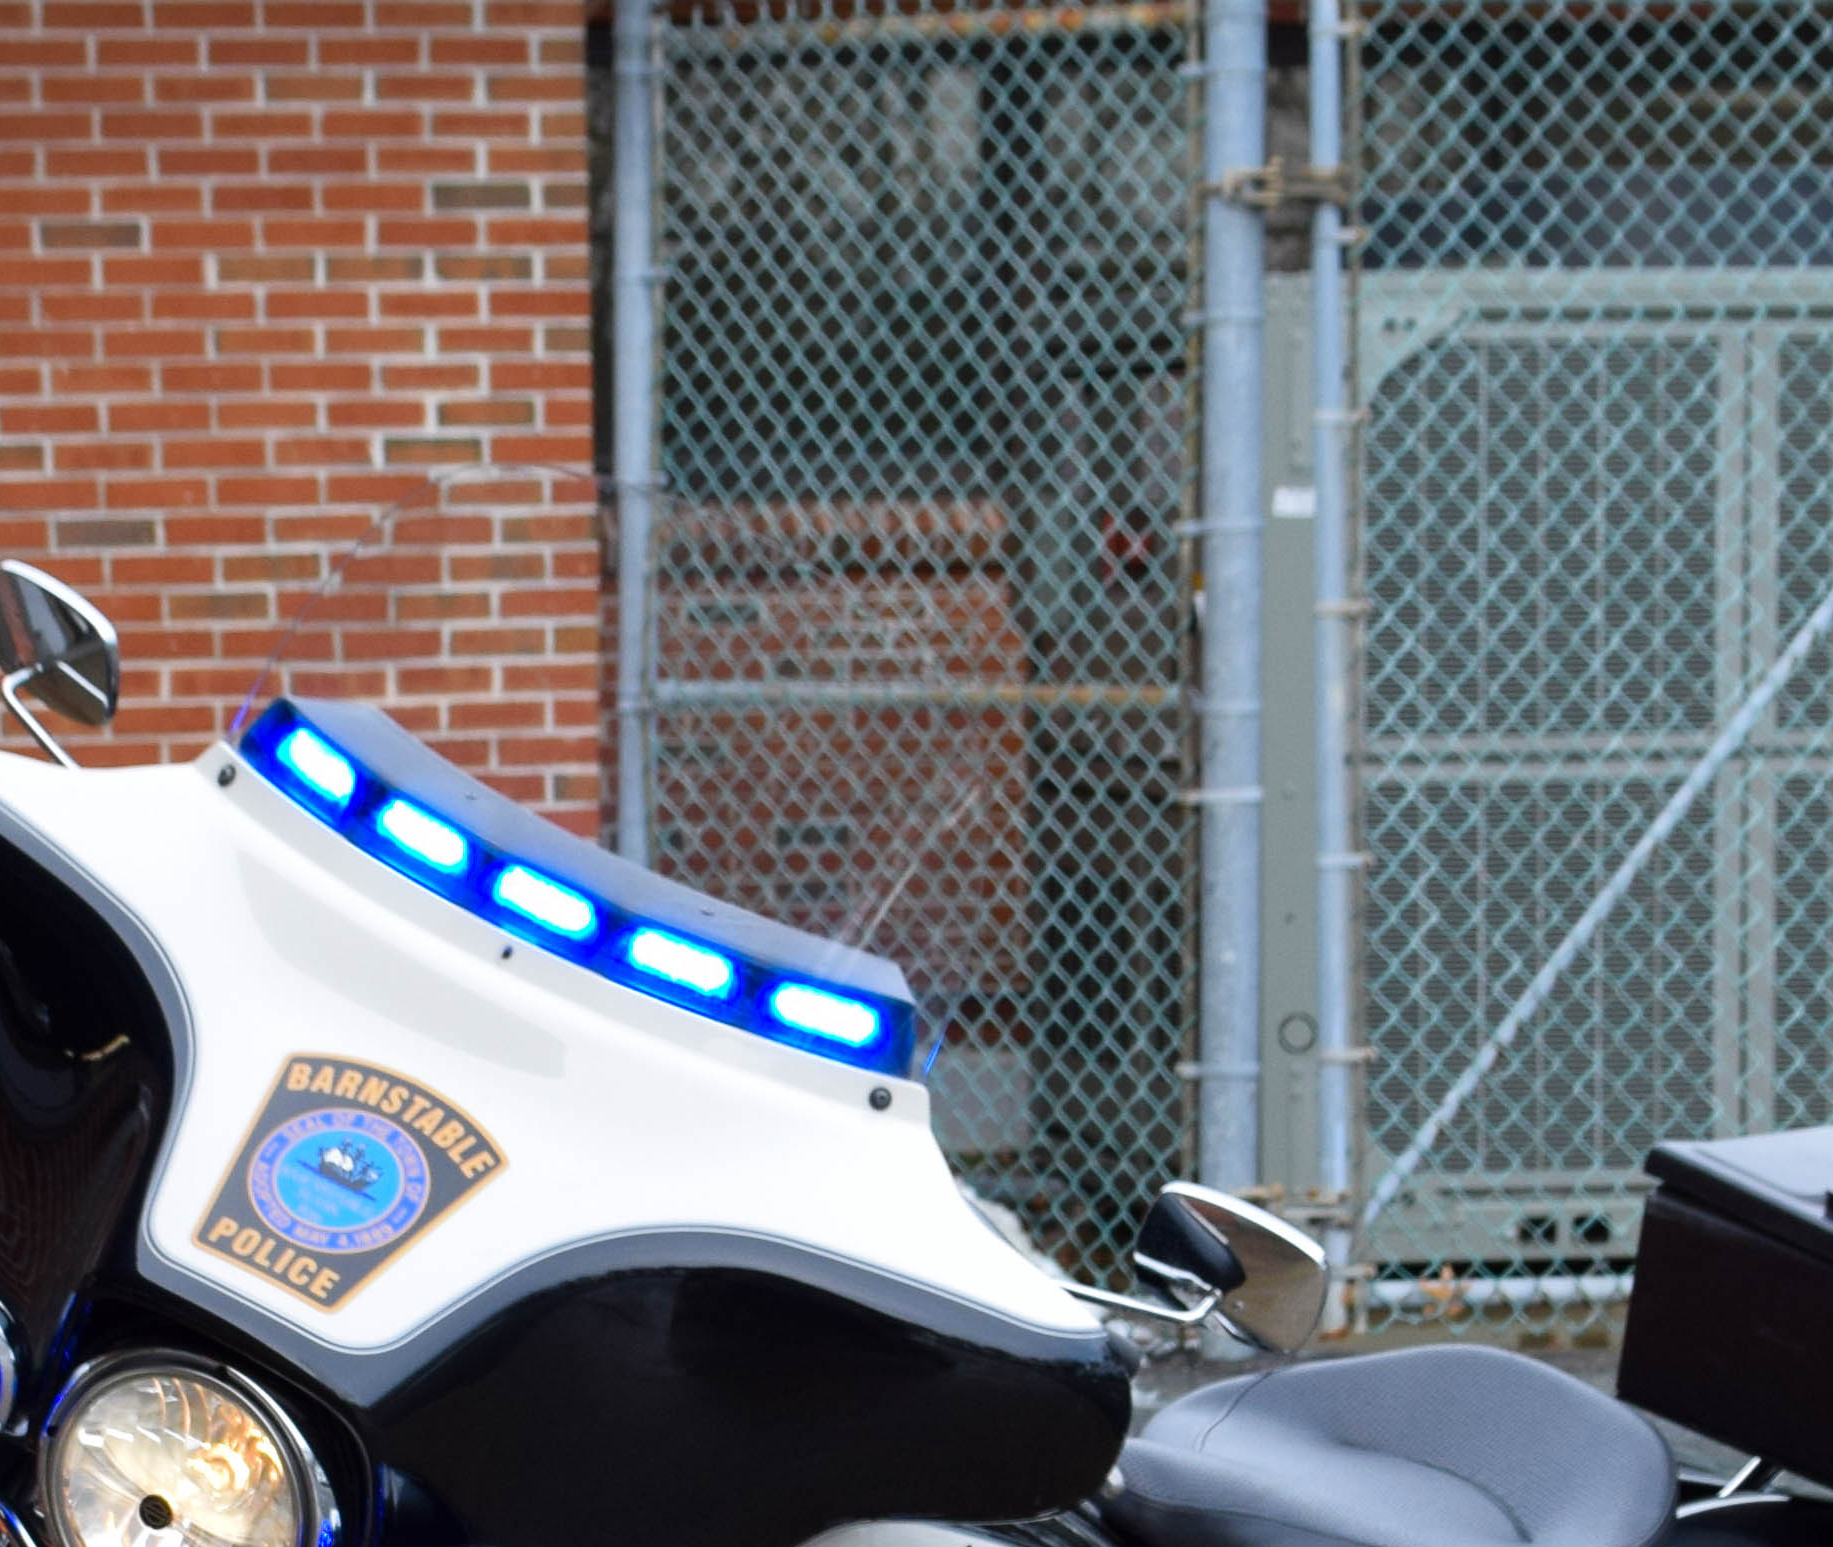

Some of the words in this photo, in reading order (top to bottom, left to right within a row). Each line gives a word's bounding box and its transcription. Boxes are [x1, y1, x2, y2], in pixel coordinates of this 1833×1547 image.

[284, 1112, 322, 1140] SEAL
[332, 1110, 356, 1128] OF
[364, 1114, 394, 1140] THE
[286, 1062, 496, 1180] BARNSTABLE
[207, 1216, 340, 1300] POLICE
